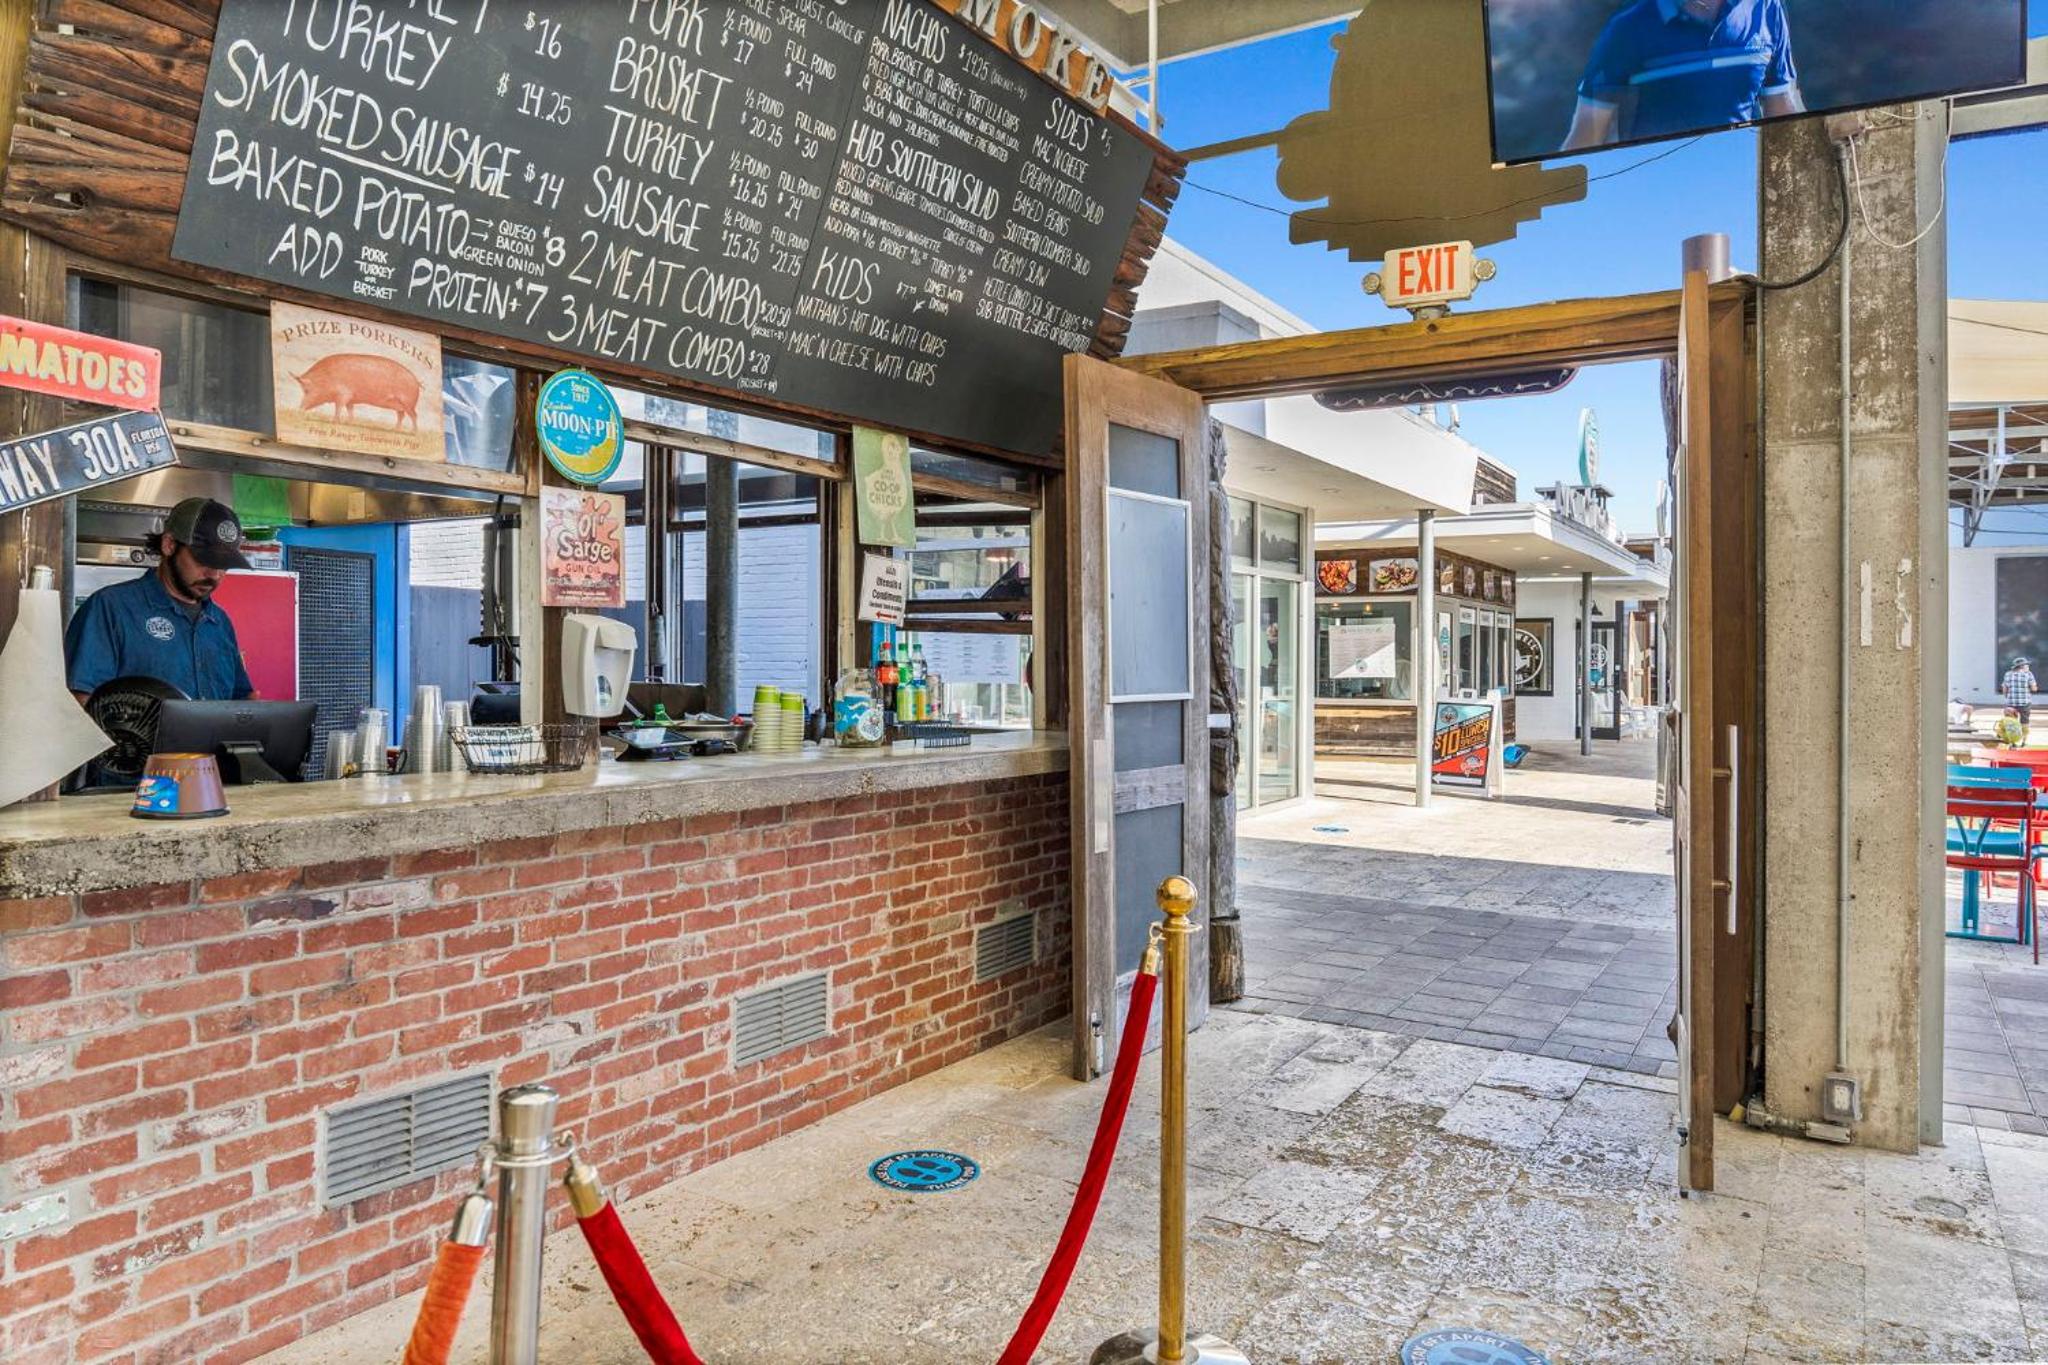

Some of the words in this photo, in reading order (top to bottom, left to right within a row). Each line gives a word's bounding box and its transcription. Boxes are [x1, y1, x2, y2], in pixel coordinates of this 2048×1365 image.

[738, 14, 773, 45] POUND
[777, 5, 807, 38] SPEAR
[881, 0, 950, 64] NACHOS
[784, 39, 808, 68] FULL
[810, 53, 838, 81] POUND
[867, 55, 890, 80] PILED
[609, 36, 735, 131] BRISKET
[213, 39, 383, 153] SMOKED
[381, 107, 521, 199] SAUSAGE
[755, 92, 785, 119] POUND
[795, 111, 814, 136] FULL
[812, 117, 837, 142] POUND
[1045, 97, 1095, 152] SIDES
[604, 104, 715, 186] TURKEY
[741, 154, 771, 180] POUND
[839, 160, 866, 183] MIXED
[846, 120, 885, 168] HUB
[885, 140, 962, 203] SOUTHERN
[956, 173, 1000, 221] SALAD
[207, 128, 343, 219] BAKED
[353, 175, 470, 260] POTATO
[499, 219, 537, 243] QUESO
[778, 170, 799, 194] FULL
[797, 177, 821, 200] POUND
[834, 177, 852, 196] RED
[583, 165, 712, 252] SAUSAGE
[829, 195, 851, 217] HERB
[1012, 190, 1045, 222] BAKED
[1044, 208, 1071, 236] BEANS
[1081, 196, 1104, 224] SALAD
[733, 211, 763, 235] POUND
[823, 215, 844, 234] ADD
[268, 223, 344, 280] ADD
[495, 235, 535, 258] BACON
[770, 226, 787, 246] FULL
[787, 233, 811, 252] POUND
[354, 259, 396, 281] TURKEY
[361, 246, 389, 265] PORK
[463, 245, 504, 268] GREEN
[506, 255, 545, 278] ONION
[1398, 245, 1459, 297] EXIT
[353, 281, 398, 301] BRISKET
[407, 257, 511, 321] PROTEIN
[568, 230, 599, 285] 2
[595, 241, 686, 308] MEAT
[682, 266, 762, 331] COMBO
[811, 245, 881, 306] KIDS
[547, 293, 577, 342] 3
[577, 303, 668, 363] MEAT
[668, 325, 745, 380] COMBO
[795, 294, 848, 328] NATHAN'S
[851, 309, 871, 335] HOT
[869, 315, 891, 340] DOG
[890, 322, 919, 347] WITH
[918, 330, 948, 360] CHIPS
[282, 320, 342, 343] PRIZE
[349, 322, 434, 370] PORKERS
[828, 338, 871, 371] CHEESE
[874, 350, 905, 381] WITH
[905, 359, 937, 388] CHIPS
[130, 427, 165, 445] FLORIDA
[330, 428, 357, 443] Range
[541, 408, 592, 436] MOON
[68, 421, 140, 480] 30A
[144, 441, 161, 455] USA
[557, 532, 614, 564] Sarge
[566, 563, 584, 574] GUN
[586, 564, 602, 575] OIL
[1434, 728, 1460, 758] $10
[1451, 1333, 1509, 1349] APART
